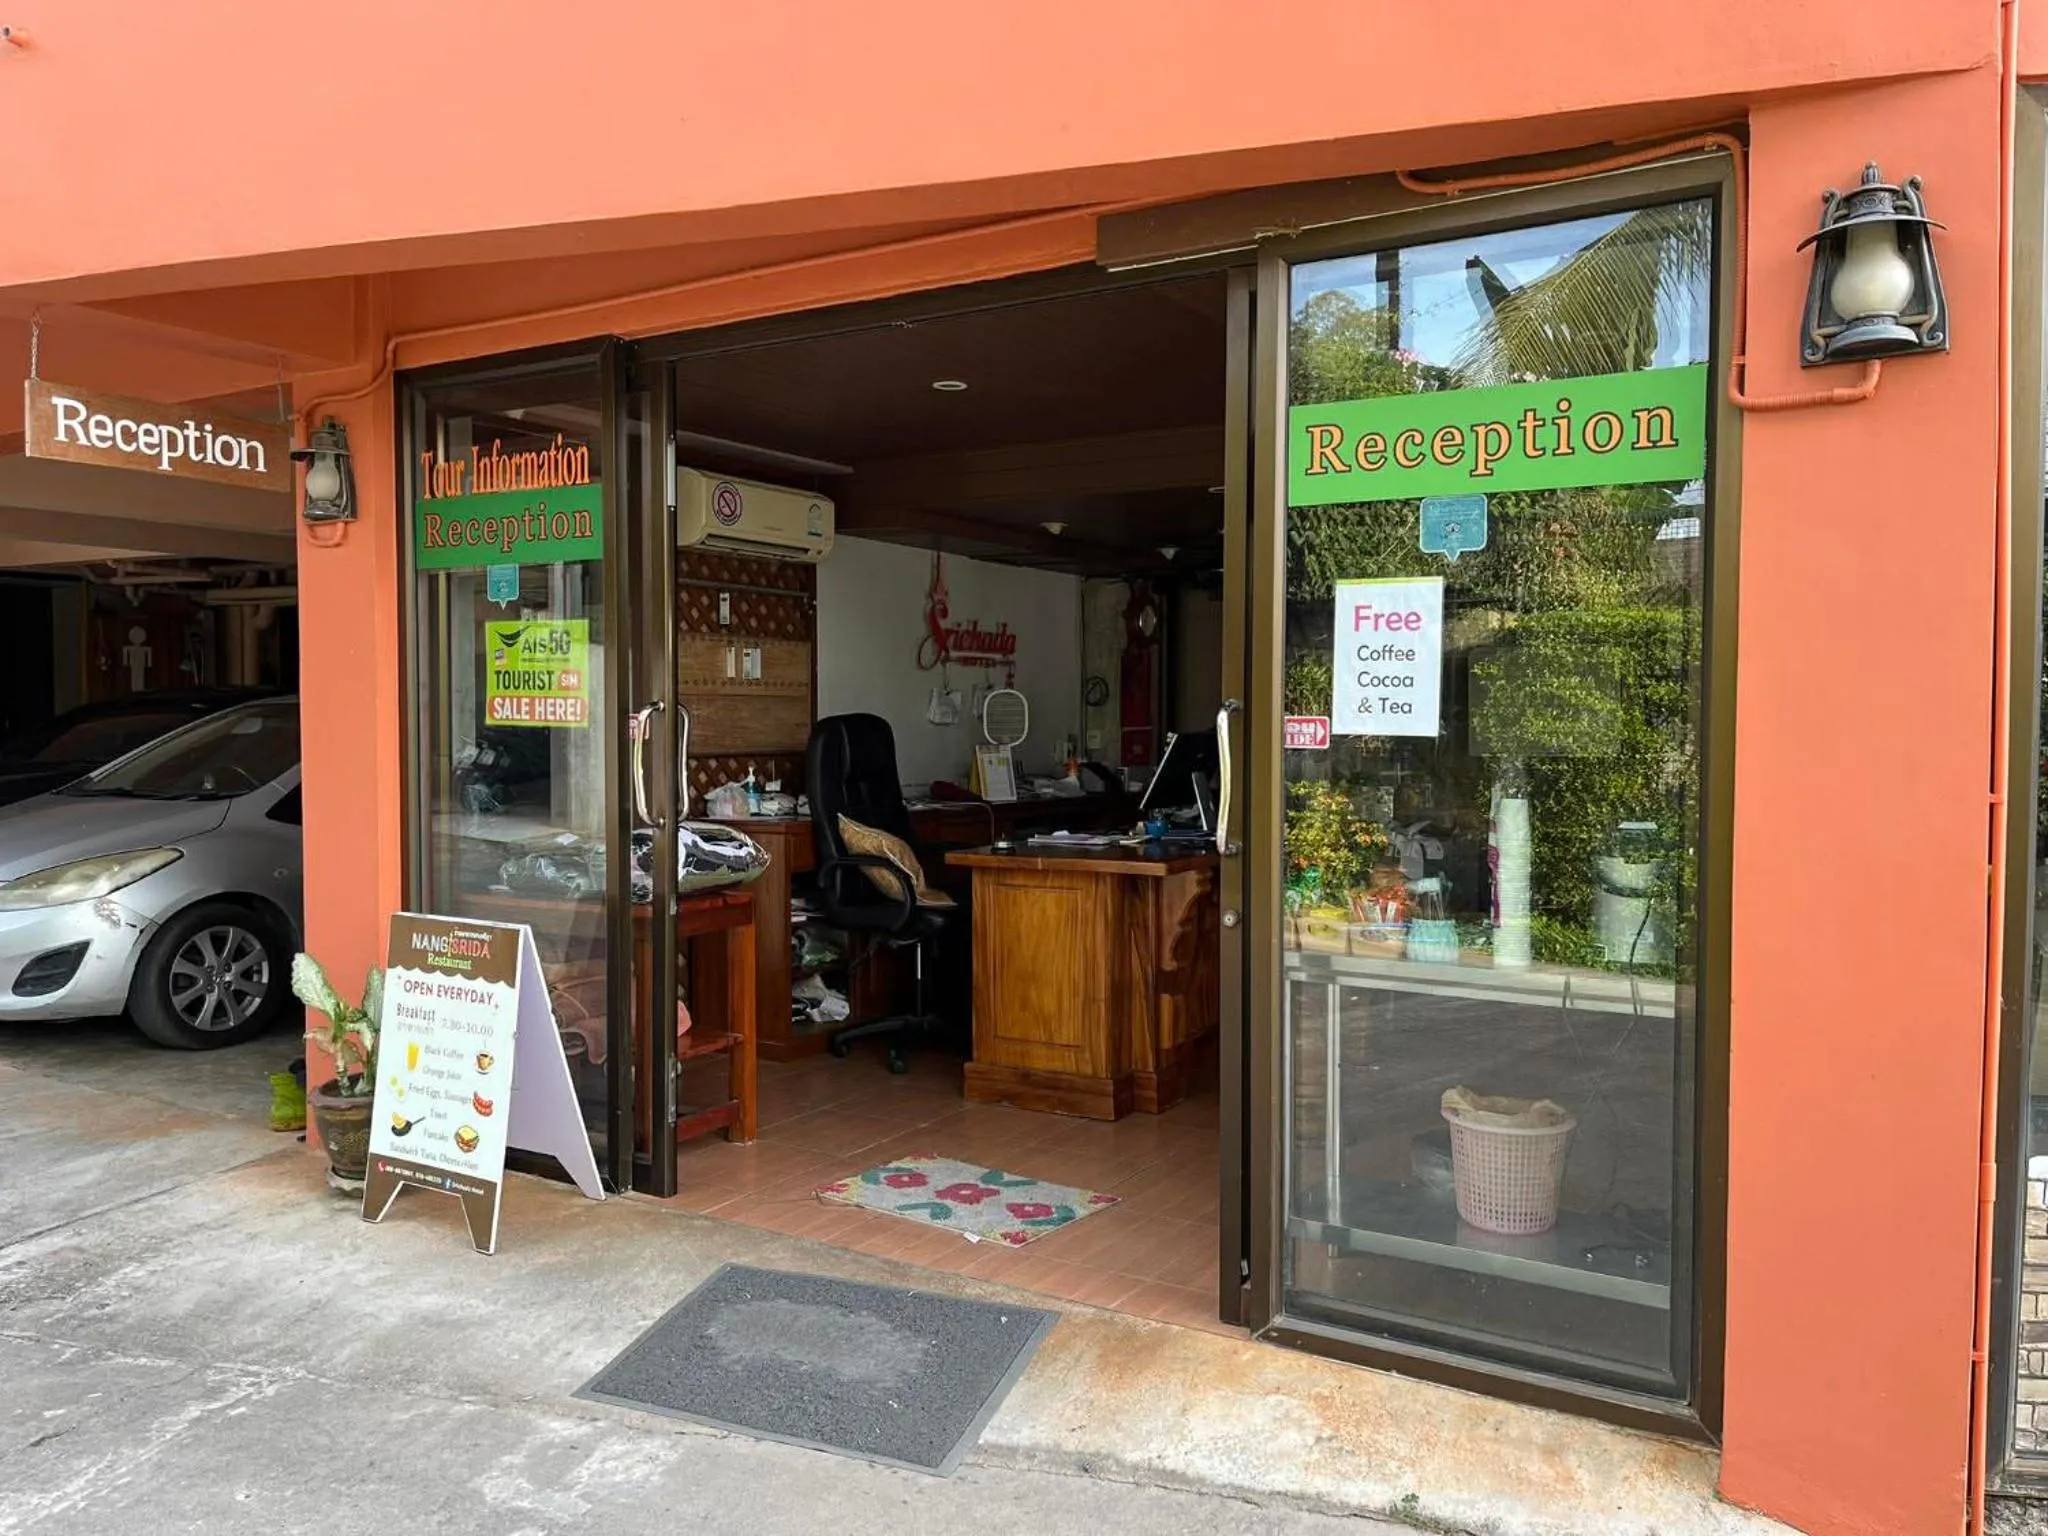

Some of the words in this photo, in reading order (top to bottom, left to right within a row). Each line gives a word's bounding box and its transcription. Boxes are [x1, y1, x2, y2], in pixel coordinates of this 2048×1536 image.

[51, 396, 268, 472] Reception
[1304, 397, 1679, 478] Reception
[421, 449, 465, 499] Tour
[471, 432, 591, 494] Information
[424, 502, 593, 553] Reception
[1353, 604, 1422, 633] Free
[522, 637, 547, 655] AIS
[549, 629, 572, 655] 5G
[1357, 644, 1416, 662] Coffee
[494, 670, 555, 691] TOURIST
[1357, 671, 1414, 688] Cocoa
[493, 697, 531, 720] SALE
[535, 698, 582, 721] HERE!
[1357, 696, 1373, 714] &
[1378, 696, 1413, 714] Tea
[411, 932, 449, 954] NANG
[450, 938, 491, 960] SRIDA
[403, 979, 434, 997] OPEN
[437, 983, 494, 1006] EVERYDAY
[396, 1002, 436, 1022] Breakfast
